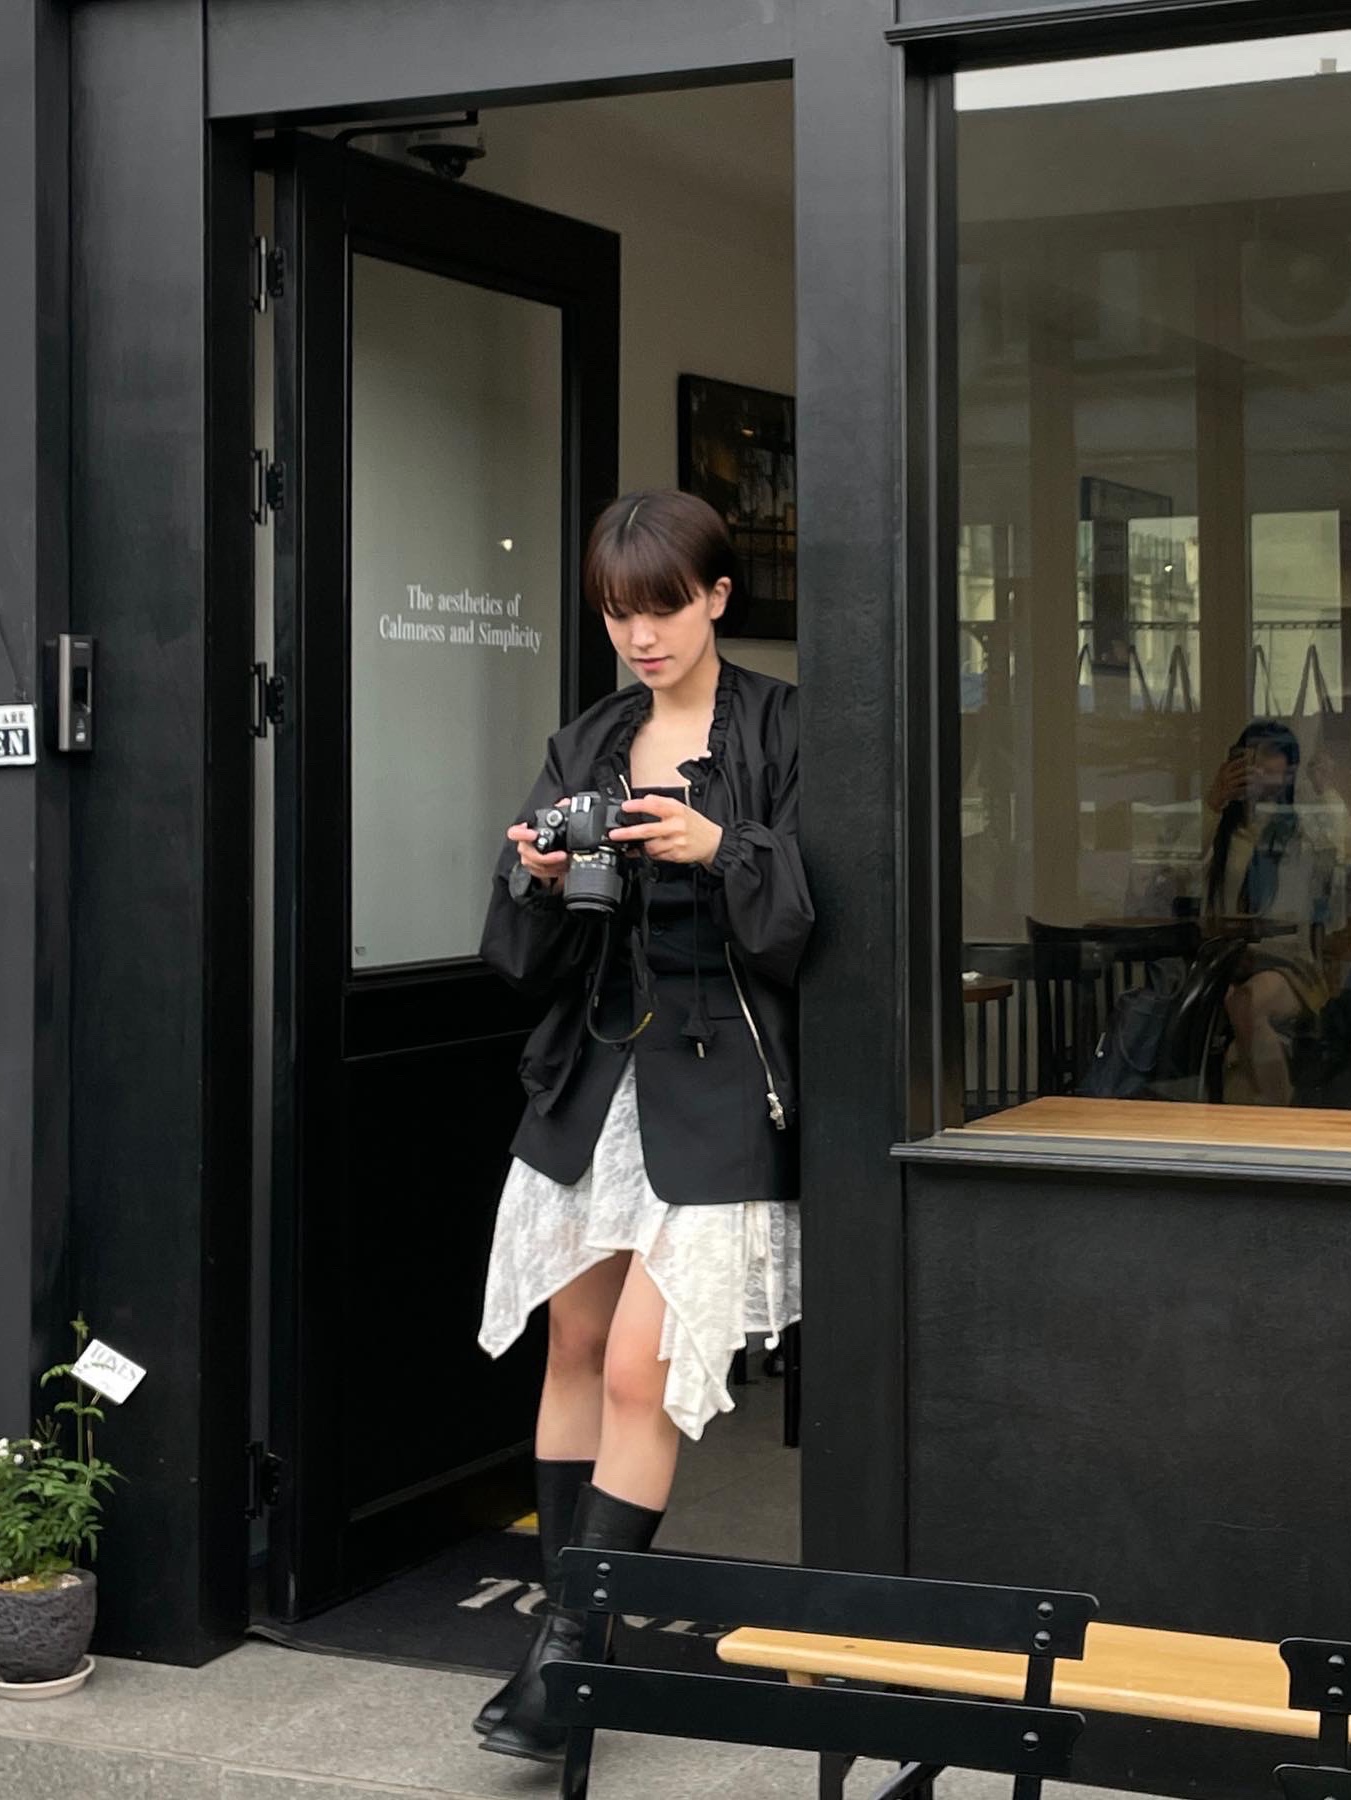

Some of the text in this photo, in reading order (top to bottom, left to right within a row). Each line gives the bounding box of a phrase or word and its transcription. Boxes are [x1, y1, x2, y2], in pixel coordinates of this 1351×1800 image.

[407, 584, 521, 617] The aesthetics of
[379, 613, 542, 654] Calmness and Simplicity
